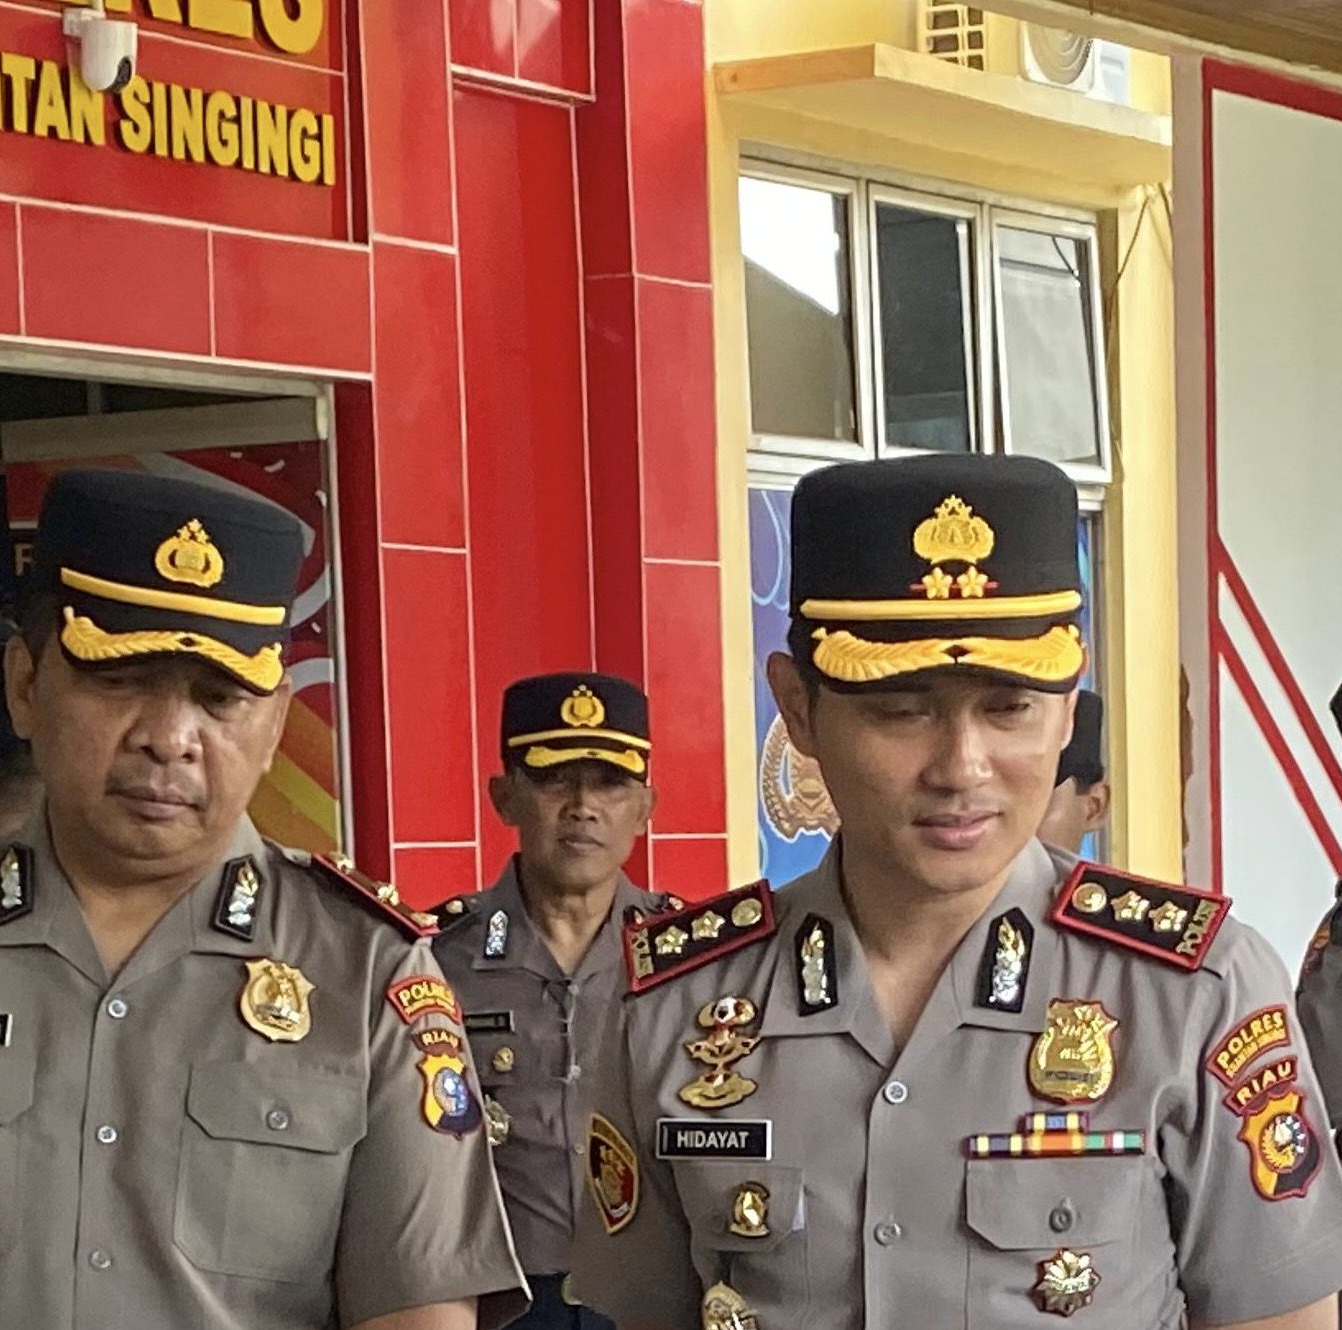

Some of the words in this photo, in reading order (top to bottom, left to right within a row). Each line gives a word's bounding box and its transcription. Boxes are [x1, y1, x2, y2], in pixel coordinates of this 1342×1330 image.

[120, 75, 336, 186] SINGINGI
[1216, 1010, 1284, 1070] POLRES
[1236, 1061, 1292, 1106] RIAU
[676, 1129, 749, 1149] HIDAYAT
